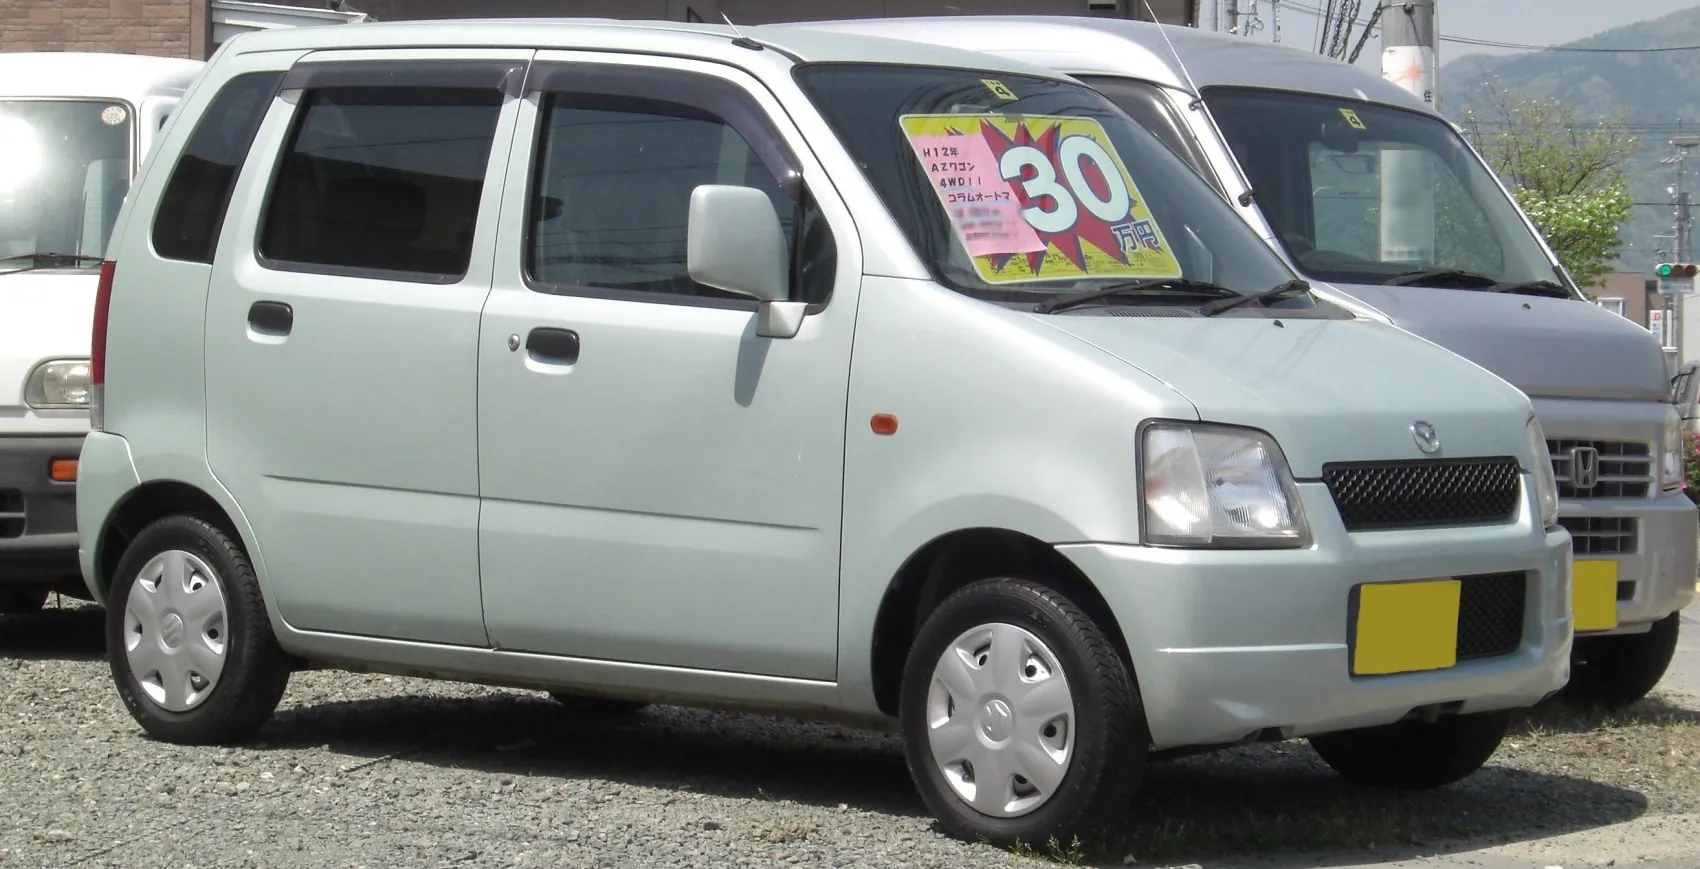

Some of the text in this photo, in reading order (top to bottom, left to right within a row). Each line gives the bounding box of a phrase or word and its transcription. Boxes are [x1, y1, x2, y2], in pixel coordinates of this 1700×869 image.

[923, 147, 959, 157] H12年
[932, 162, 975, 172] AZワゴン
[948, 191, 1010, 203] コラムオートマ
[1000, 135, 1160, 254] 30 万円
